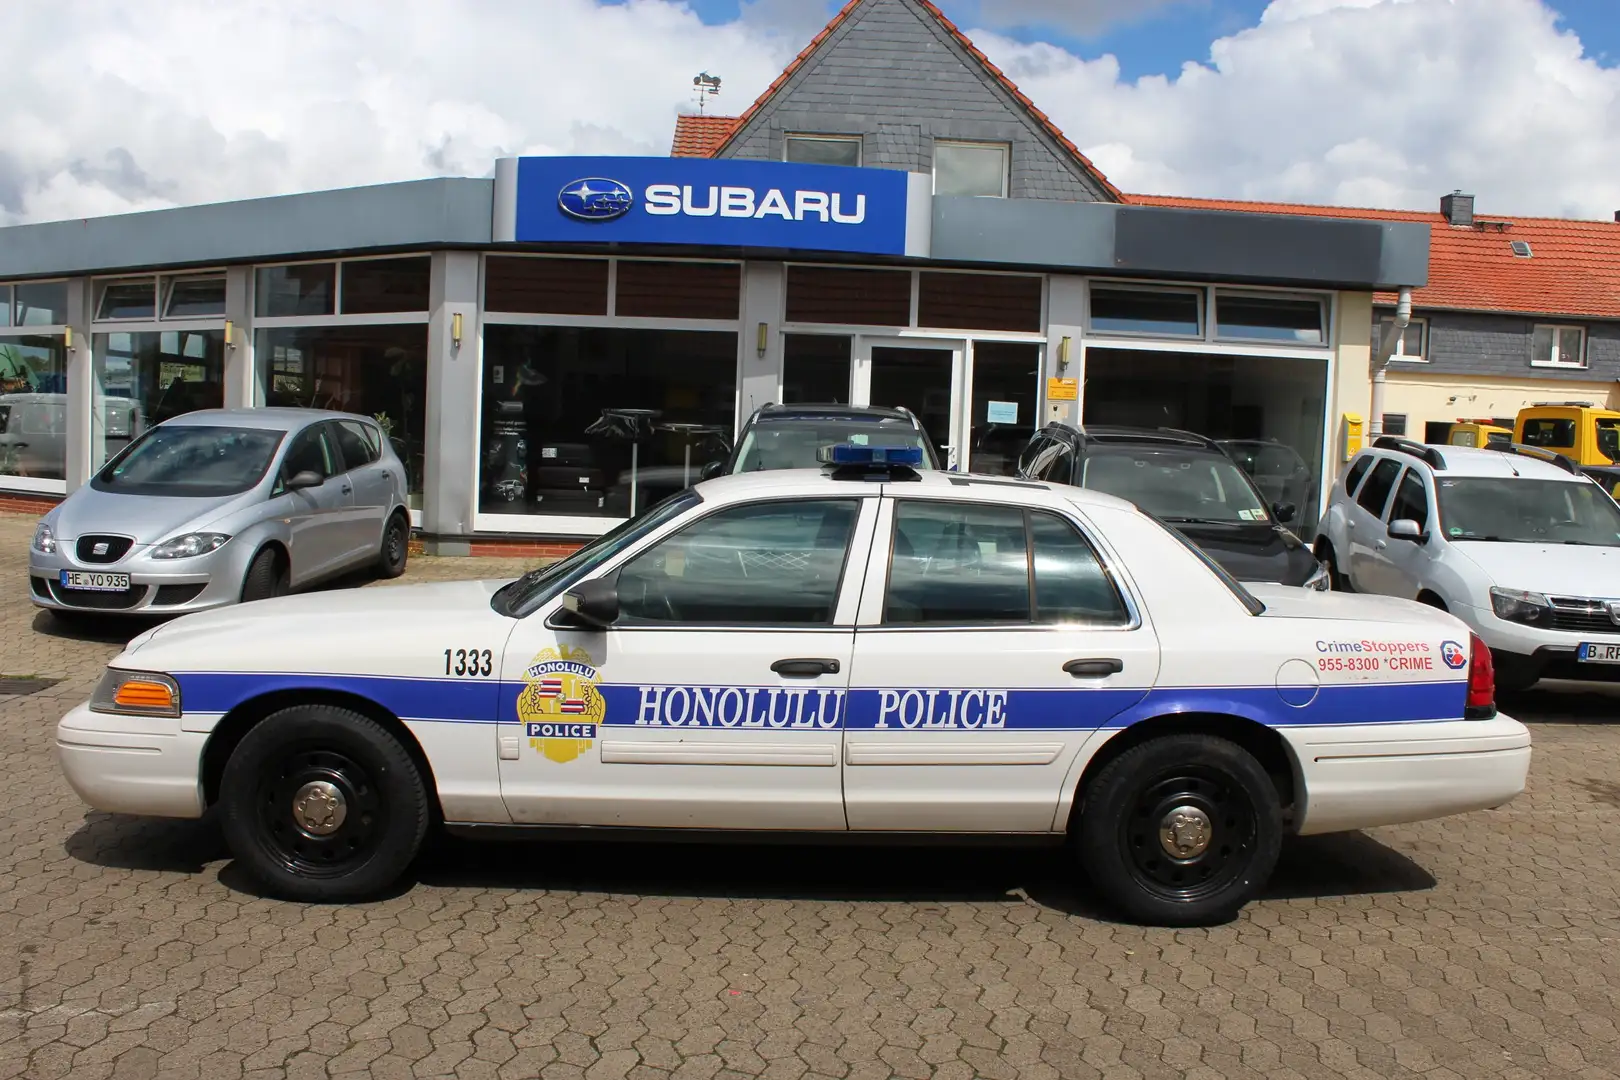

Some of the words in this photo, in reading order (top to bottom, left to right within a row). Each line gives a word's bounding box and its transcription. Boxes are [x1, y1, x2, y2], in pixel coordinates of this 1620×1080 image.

[645, 184, 866, 224] SUBARU
[67, 573, 82, 585] HE
[107, 576, 128, 587] 935
[1316, 640, 1430, 655] CrimeStoppers
[1588, 645, 1597, 658] B
[444, 648, 493, 677] 1333
[529, 662, 594, 678] HONOLULU
[1318, 658, 1379, 671] 955-8300
[635, 686, 847, 730] HONOLULU
[874, 689, 1008, 730] POLICE
[530, 723, 592, 737] POLICE
